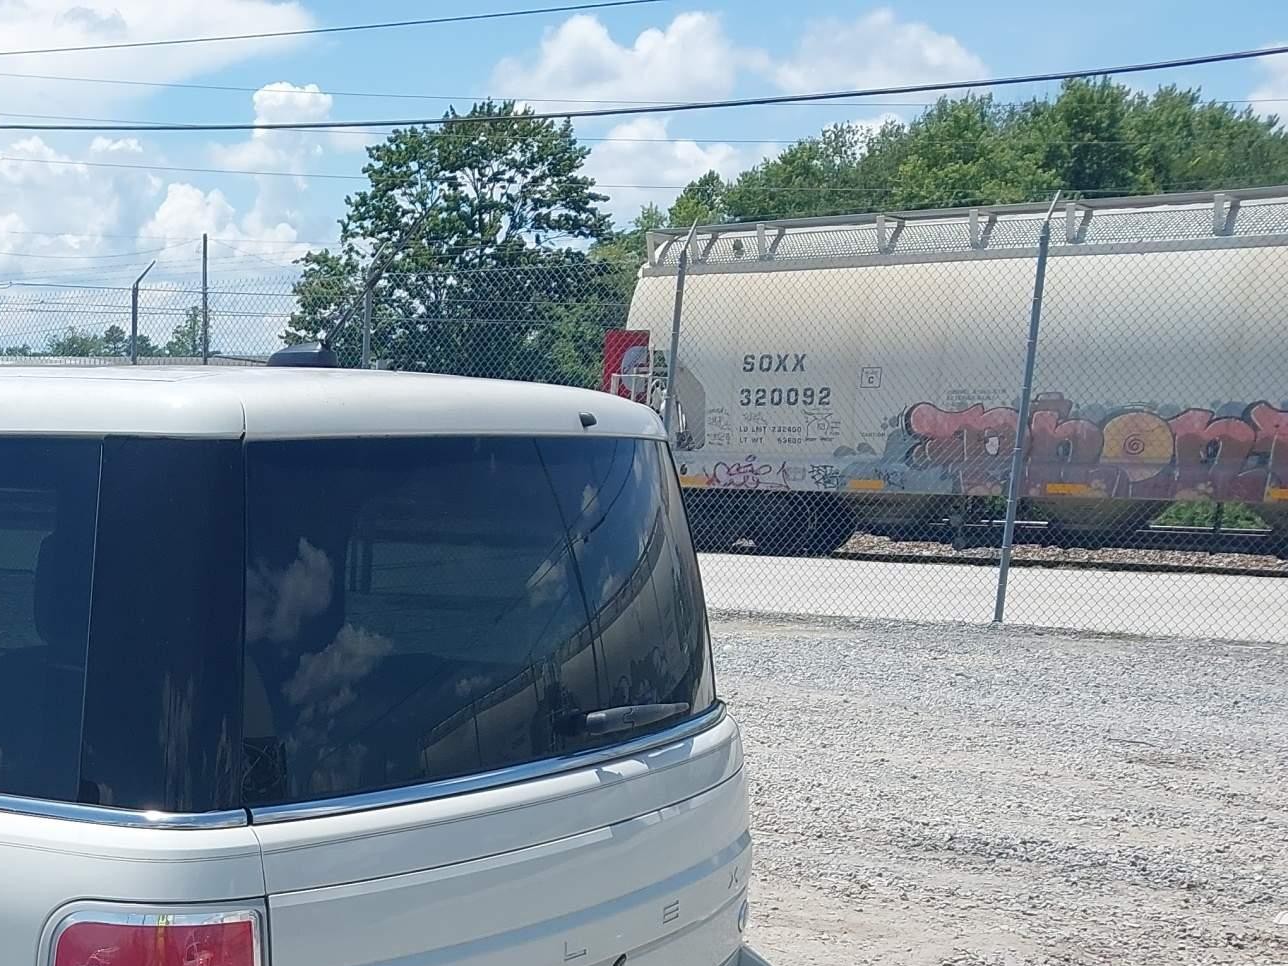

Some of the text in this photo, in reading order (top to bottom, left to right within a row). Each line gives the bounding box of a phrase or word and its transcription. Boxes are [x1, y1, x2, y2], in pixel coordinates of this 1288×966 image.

[742, 353, 807, 373] SOXX
[868, 376, 874, 384] C
[739, 387, 832, 406] 320092
